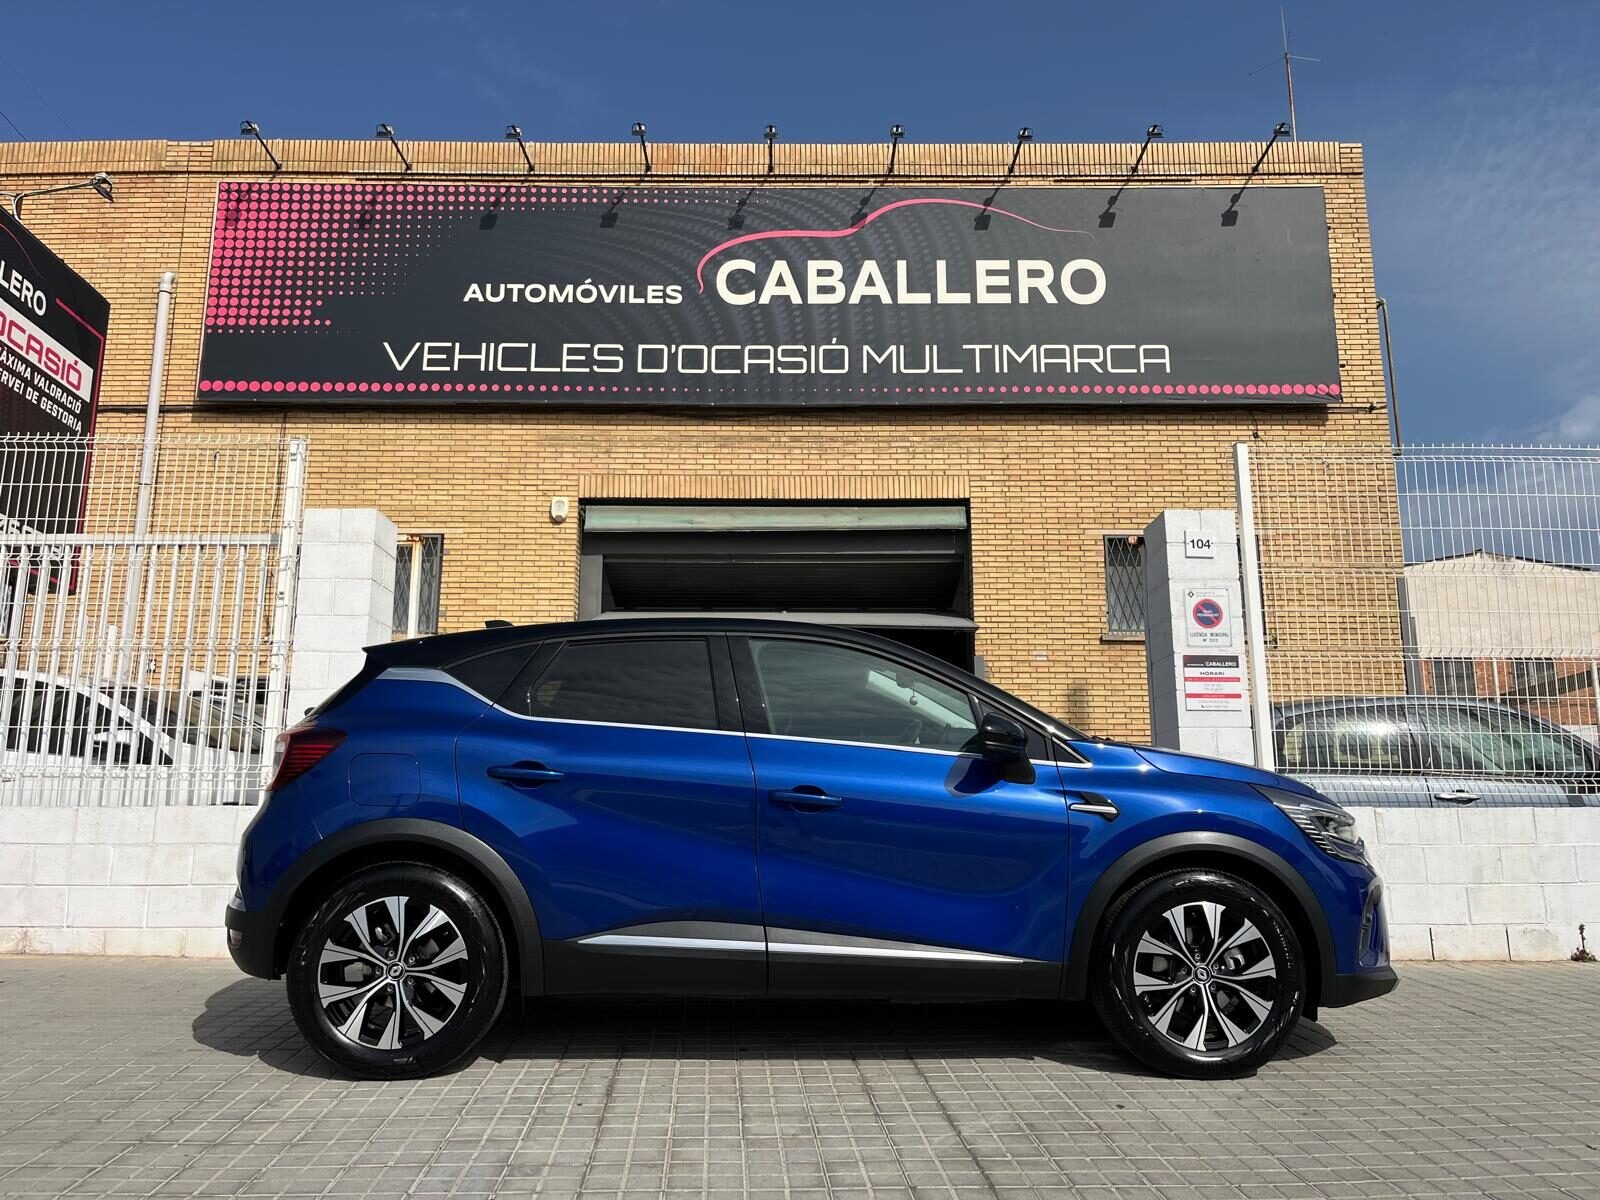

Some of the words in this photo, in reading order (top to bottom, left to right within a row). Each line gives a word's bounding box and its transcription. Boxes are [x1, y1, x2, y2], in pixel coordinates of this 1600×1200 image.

[463, 278, 683, 305] AUTOMÓVILES
[715, 258, 1108, 306] CABALLERO
[382, 342, 624, 373] VEHICLES
[637, 337, 850, 374] D'OCASIÓ
[862, 343, 1171, 374] MULTIMARCA
[0, 346, 31, 380] ÀXIMA
[33, 371, 82, 414] VALORACIÓ
[25, 386, 39, 405] DE
[40, 396, 82, 434] GESTORIA
[1189, 538, 1211, 550] 104
